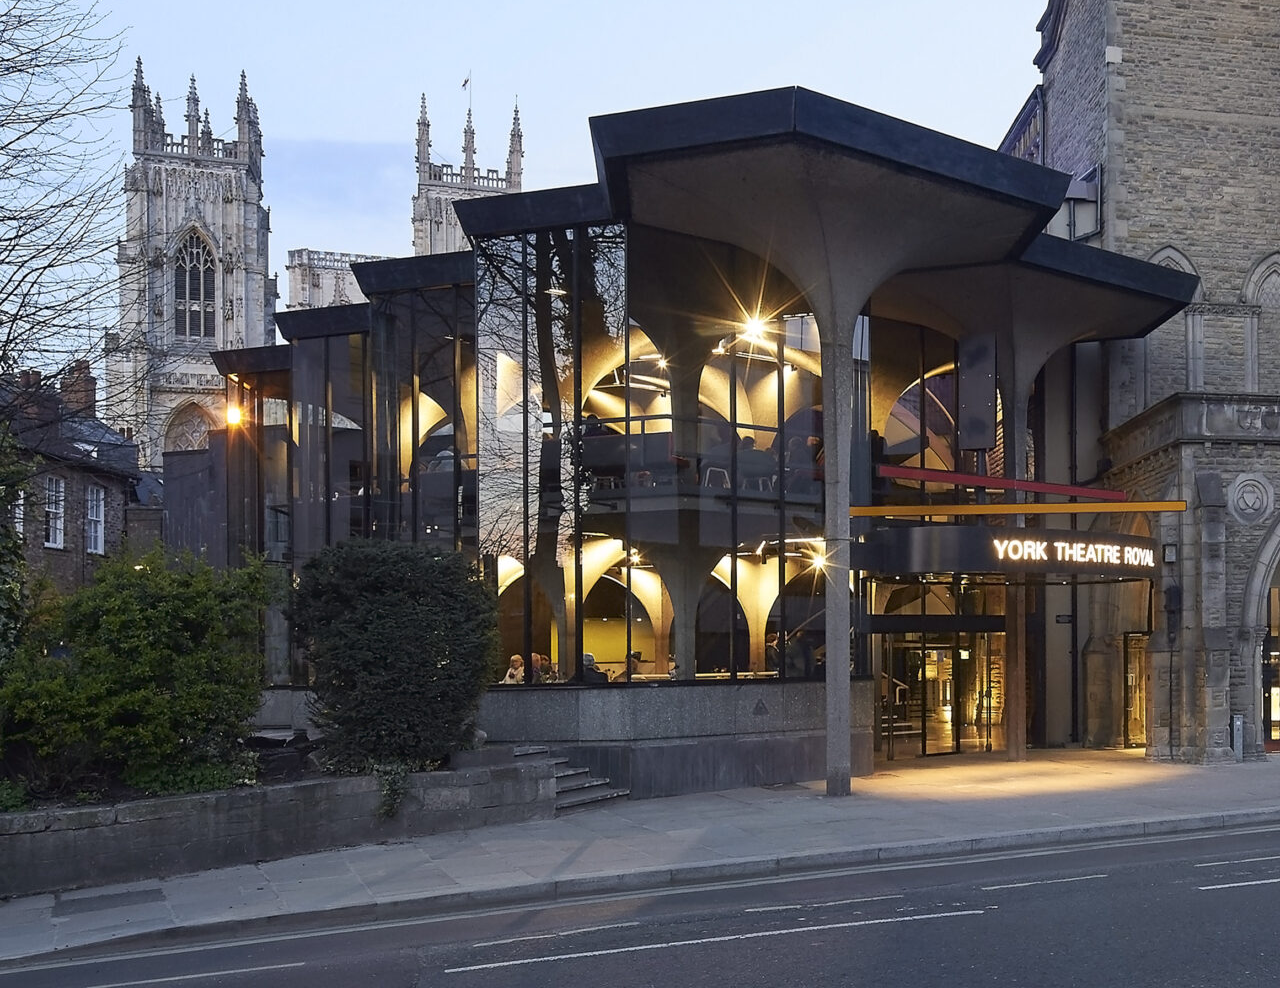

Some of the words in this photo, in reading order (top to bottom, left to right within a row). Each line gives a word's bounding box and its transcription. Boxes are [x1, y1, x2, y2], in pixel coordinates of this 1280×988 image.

[993, 539, 1048, 561] YORK
[1053, 542, 1121, 564] THEATRE
[1124, 546, 1155, 567] ROYAL
